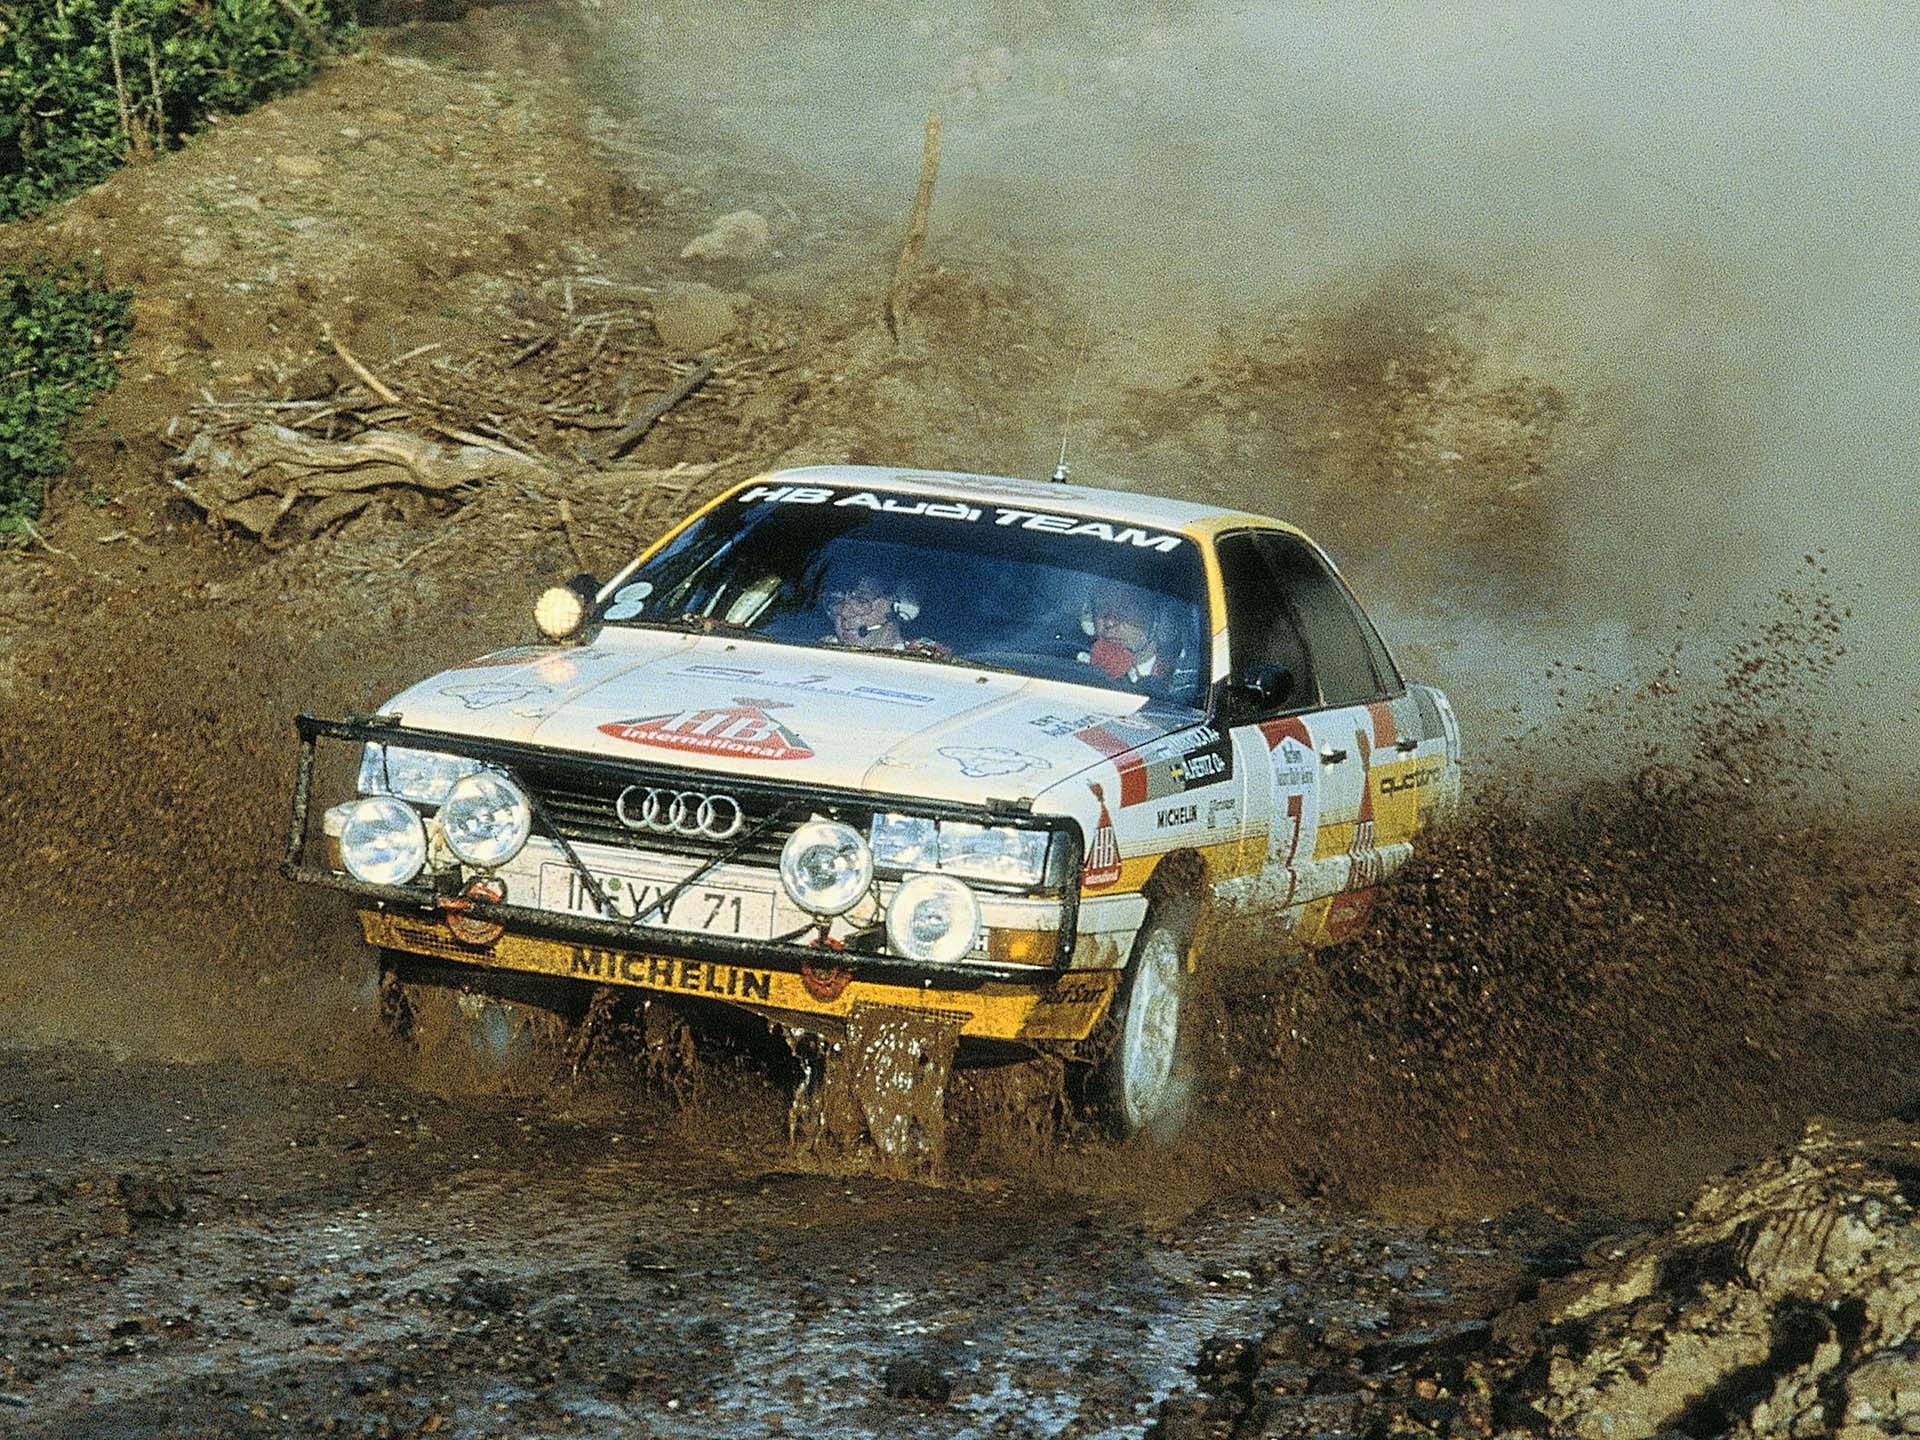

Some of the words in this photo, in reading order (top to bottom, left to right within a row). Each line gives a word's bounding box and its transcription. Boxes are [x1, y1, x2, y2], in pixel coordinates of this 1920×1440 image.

[738, 486, 834, 505] HB
[994, 508, 1182, 552] TEAM
[661, 710, 781, 743] HB
[1156, 804, 1198, 829] MICHELIN
[1092, 826, 1115, 870] HB
[703, 892, 742, 934] 71
[571, 948, 771, 1000] MICHELIN
